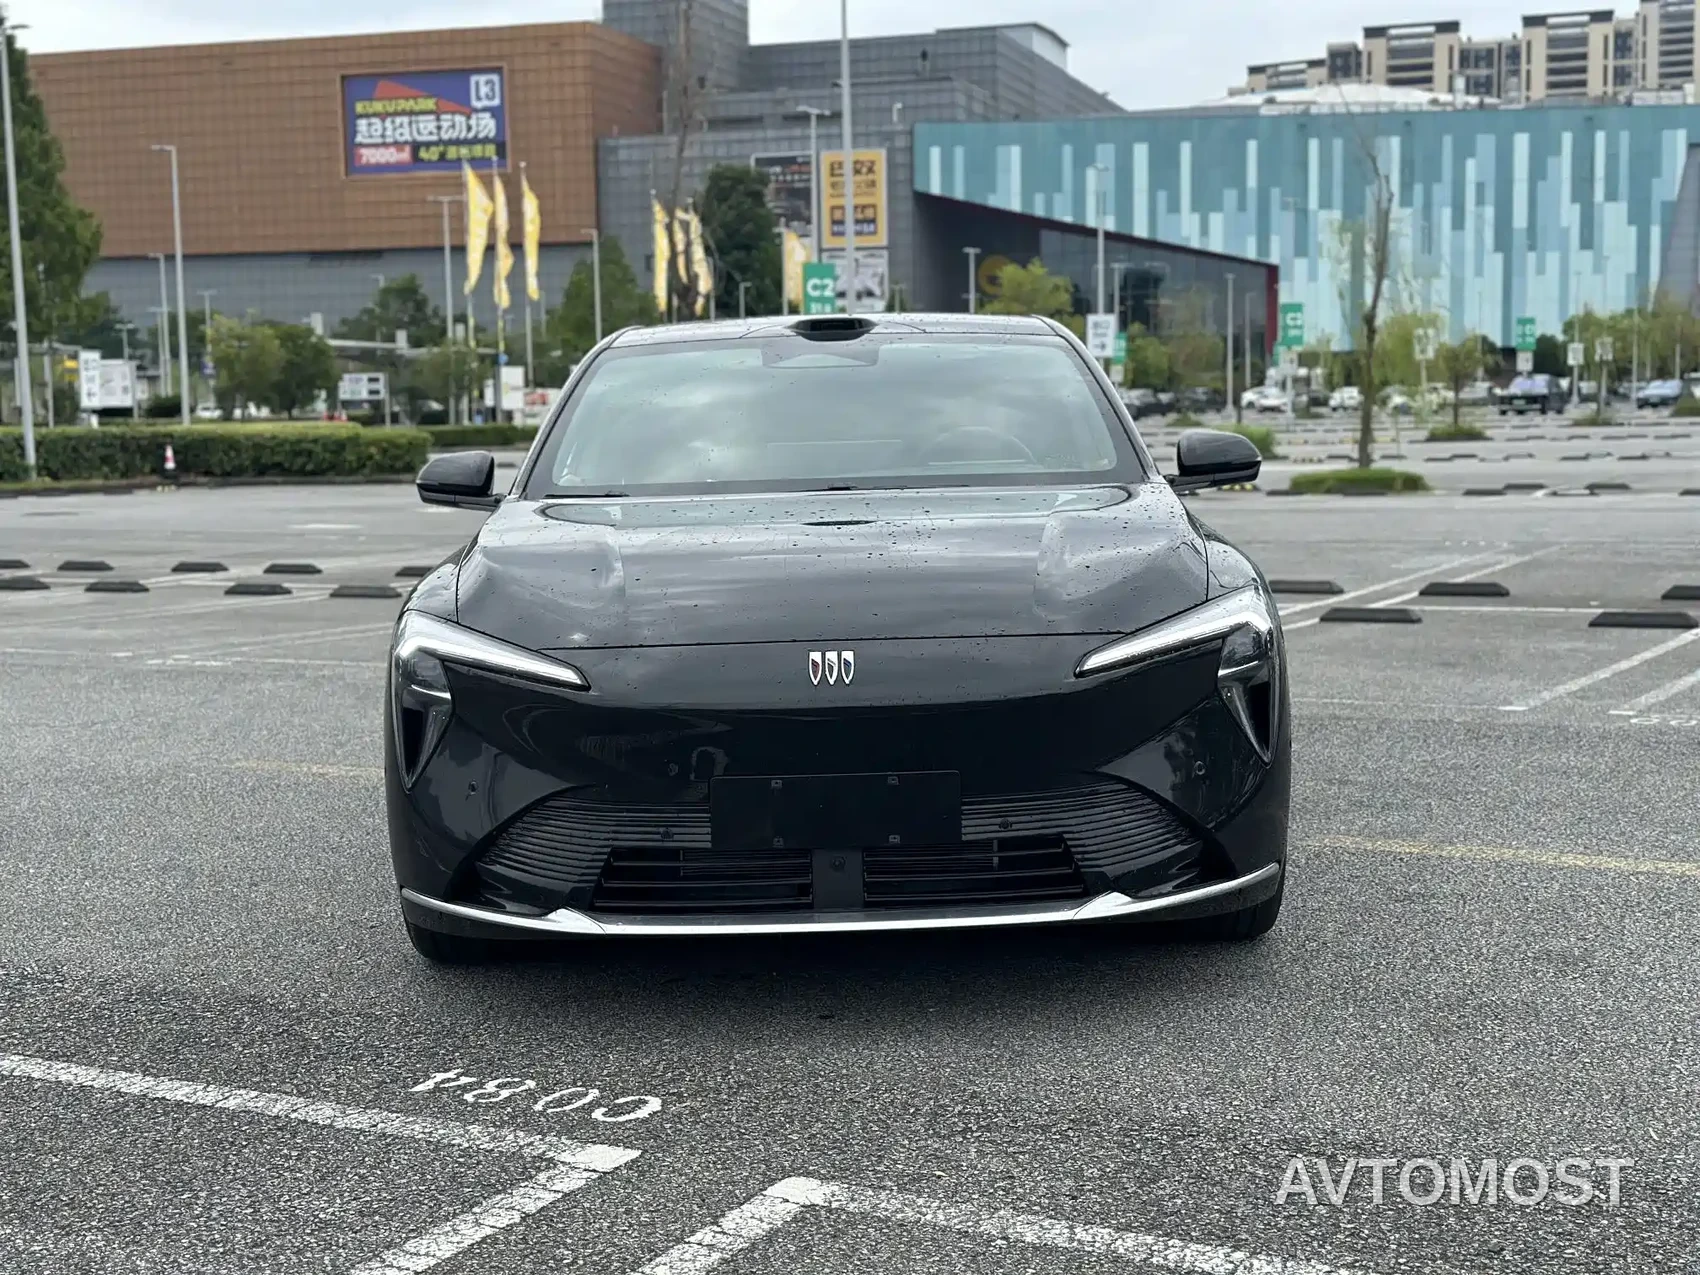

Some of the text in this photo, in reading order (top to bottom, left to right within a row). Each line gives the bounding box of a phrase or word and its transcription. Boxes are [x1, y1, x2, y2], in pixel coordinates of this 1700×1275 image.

[474, 79, 497, 102] L3
[354, 111, 497, 144] 超级运动场
[806, 277, 835, 298] C2
[408, 1068, 663, 1122] C084
